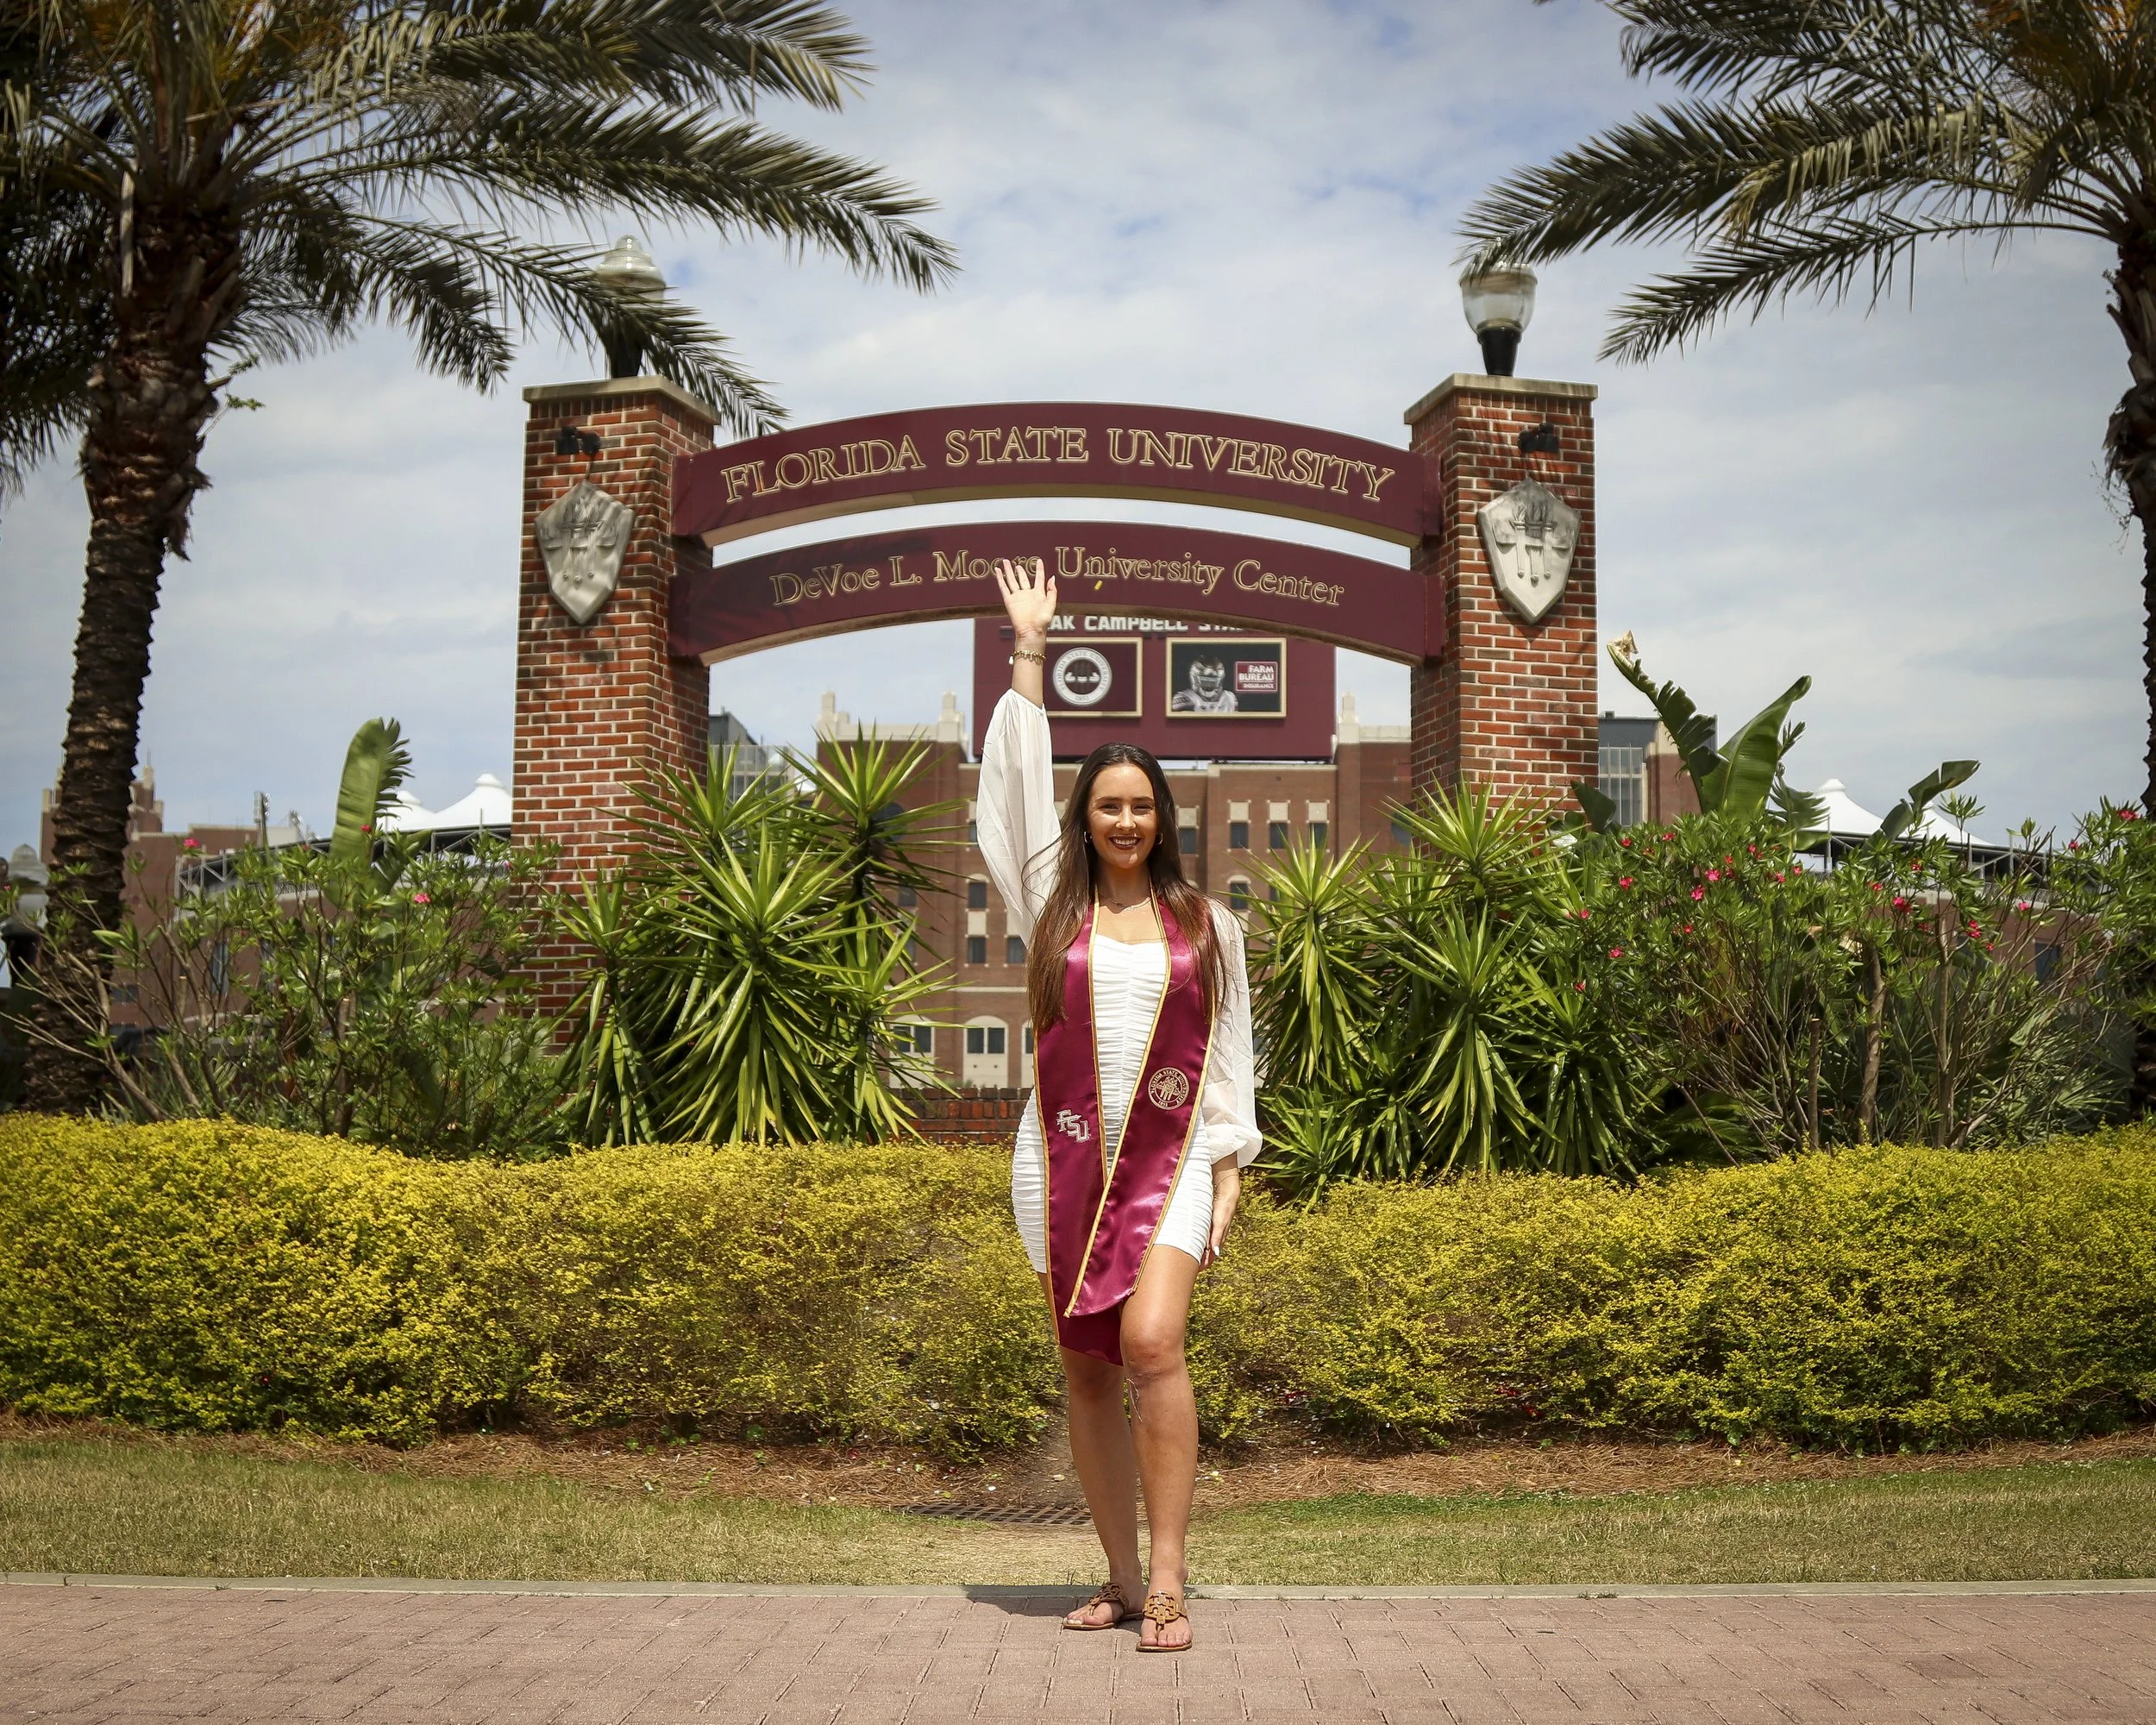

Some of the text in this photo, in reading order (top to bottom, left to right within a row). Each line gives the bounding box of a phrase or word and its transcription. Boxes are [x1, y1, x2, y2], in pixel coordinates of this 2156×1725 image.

[720, 425, 1395, 505] FLORIDA STATE UNIVERSITY
[769, 562, 881, 606] DeVoe
[889, 555, 924, 586] L.
[1055, 546, 1225, 595] University
[1232, 559, 1344, 605] Center
[1084, 615, 1189, 630] CAMPBELL
[1249, 664, 1275, 673] FARM
[1056, 1109, 1091, 1143] FSU
